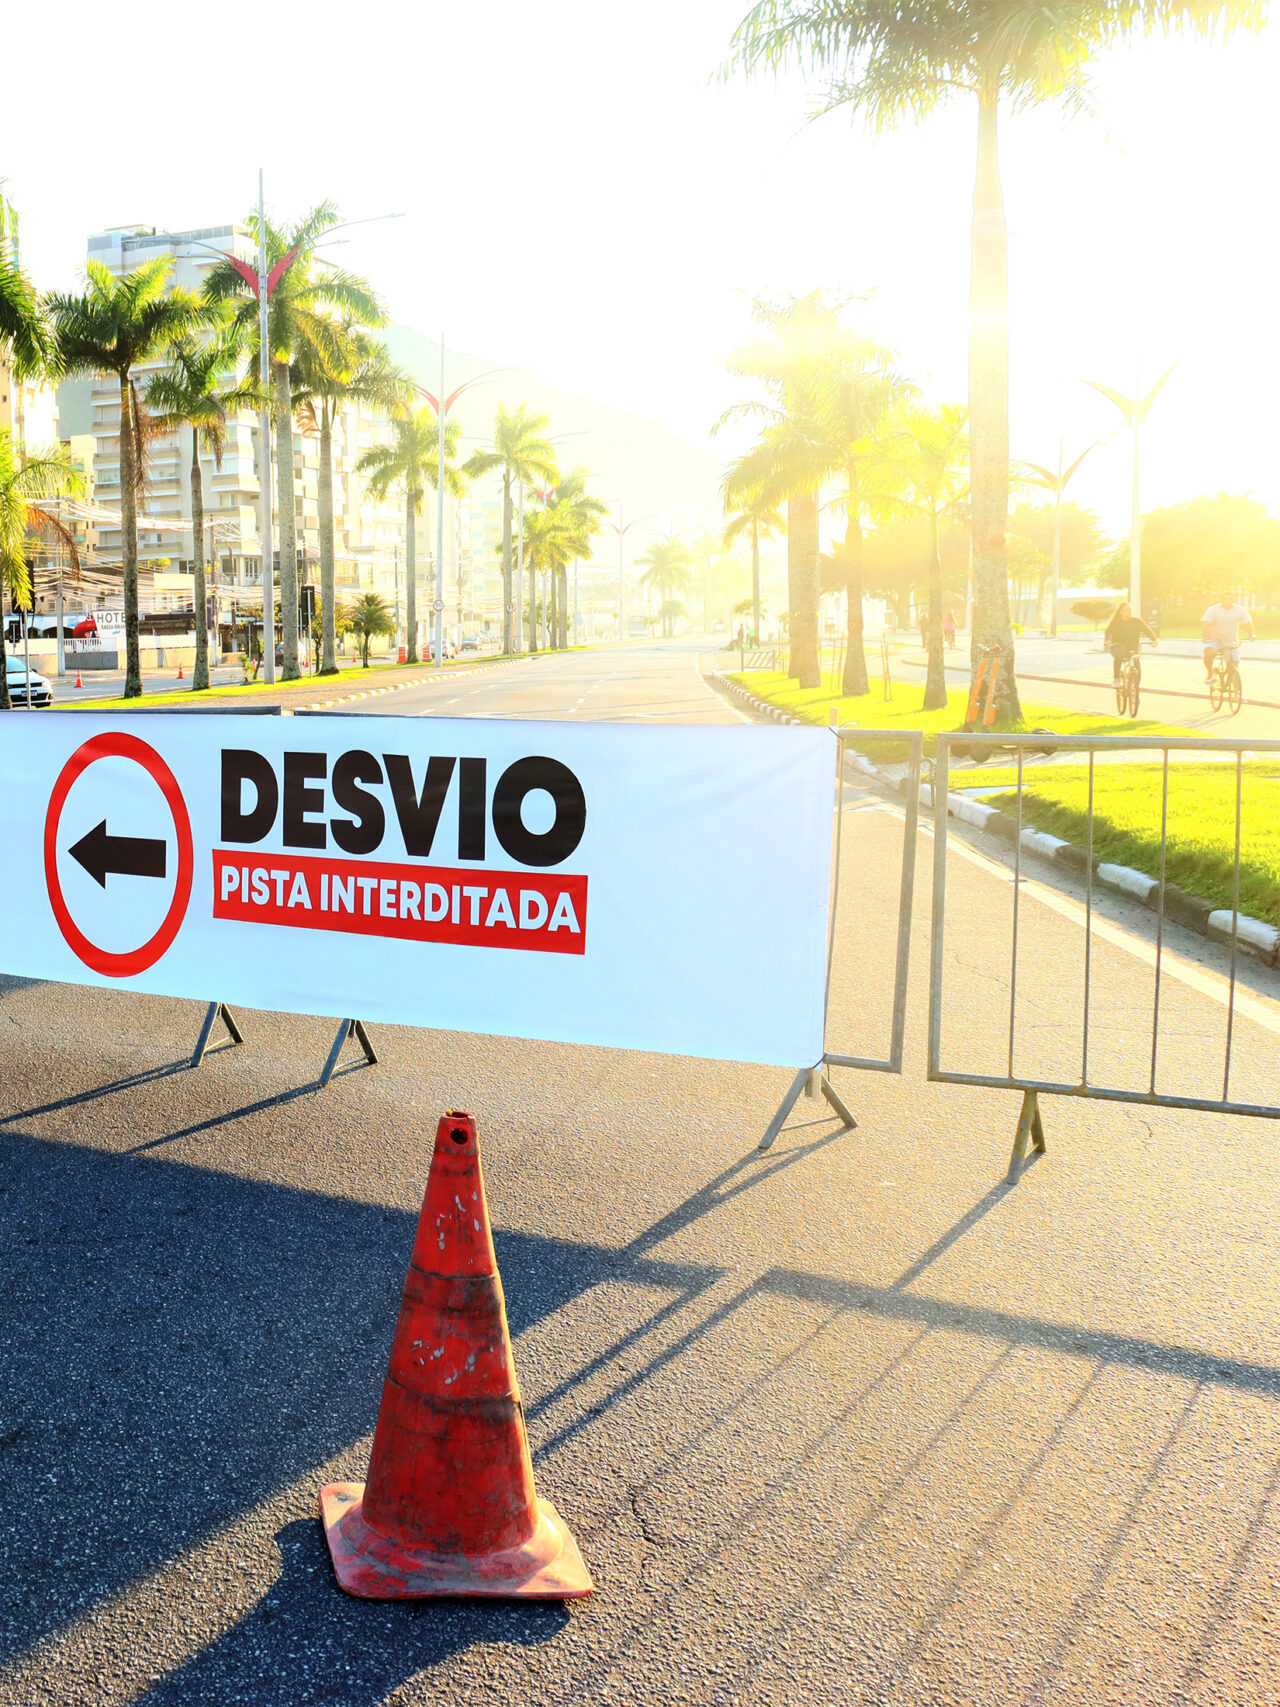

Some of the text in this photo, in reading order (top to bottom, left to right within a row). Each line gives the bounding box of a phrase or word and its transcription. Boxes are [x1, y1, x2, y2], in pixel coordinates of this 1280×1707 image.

[220, 749, 586, 867] DESVIO
[220, 866, 581, 934] PISTA INTERDITADA
